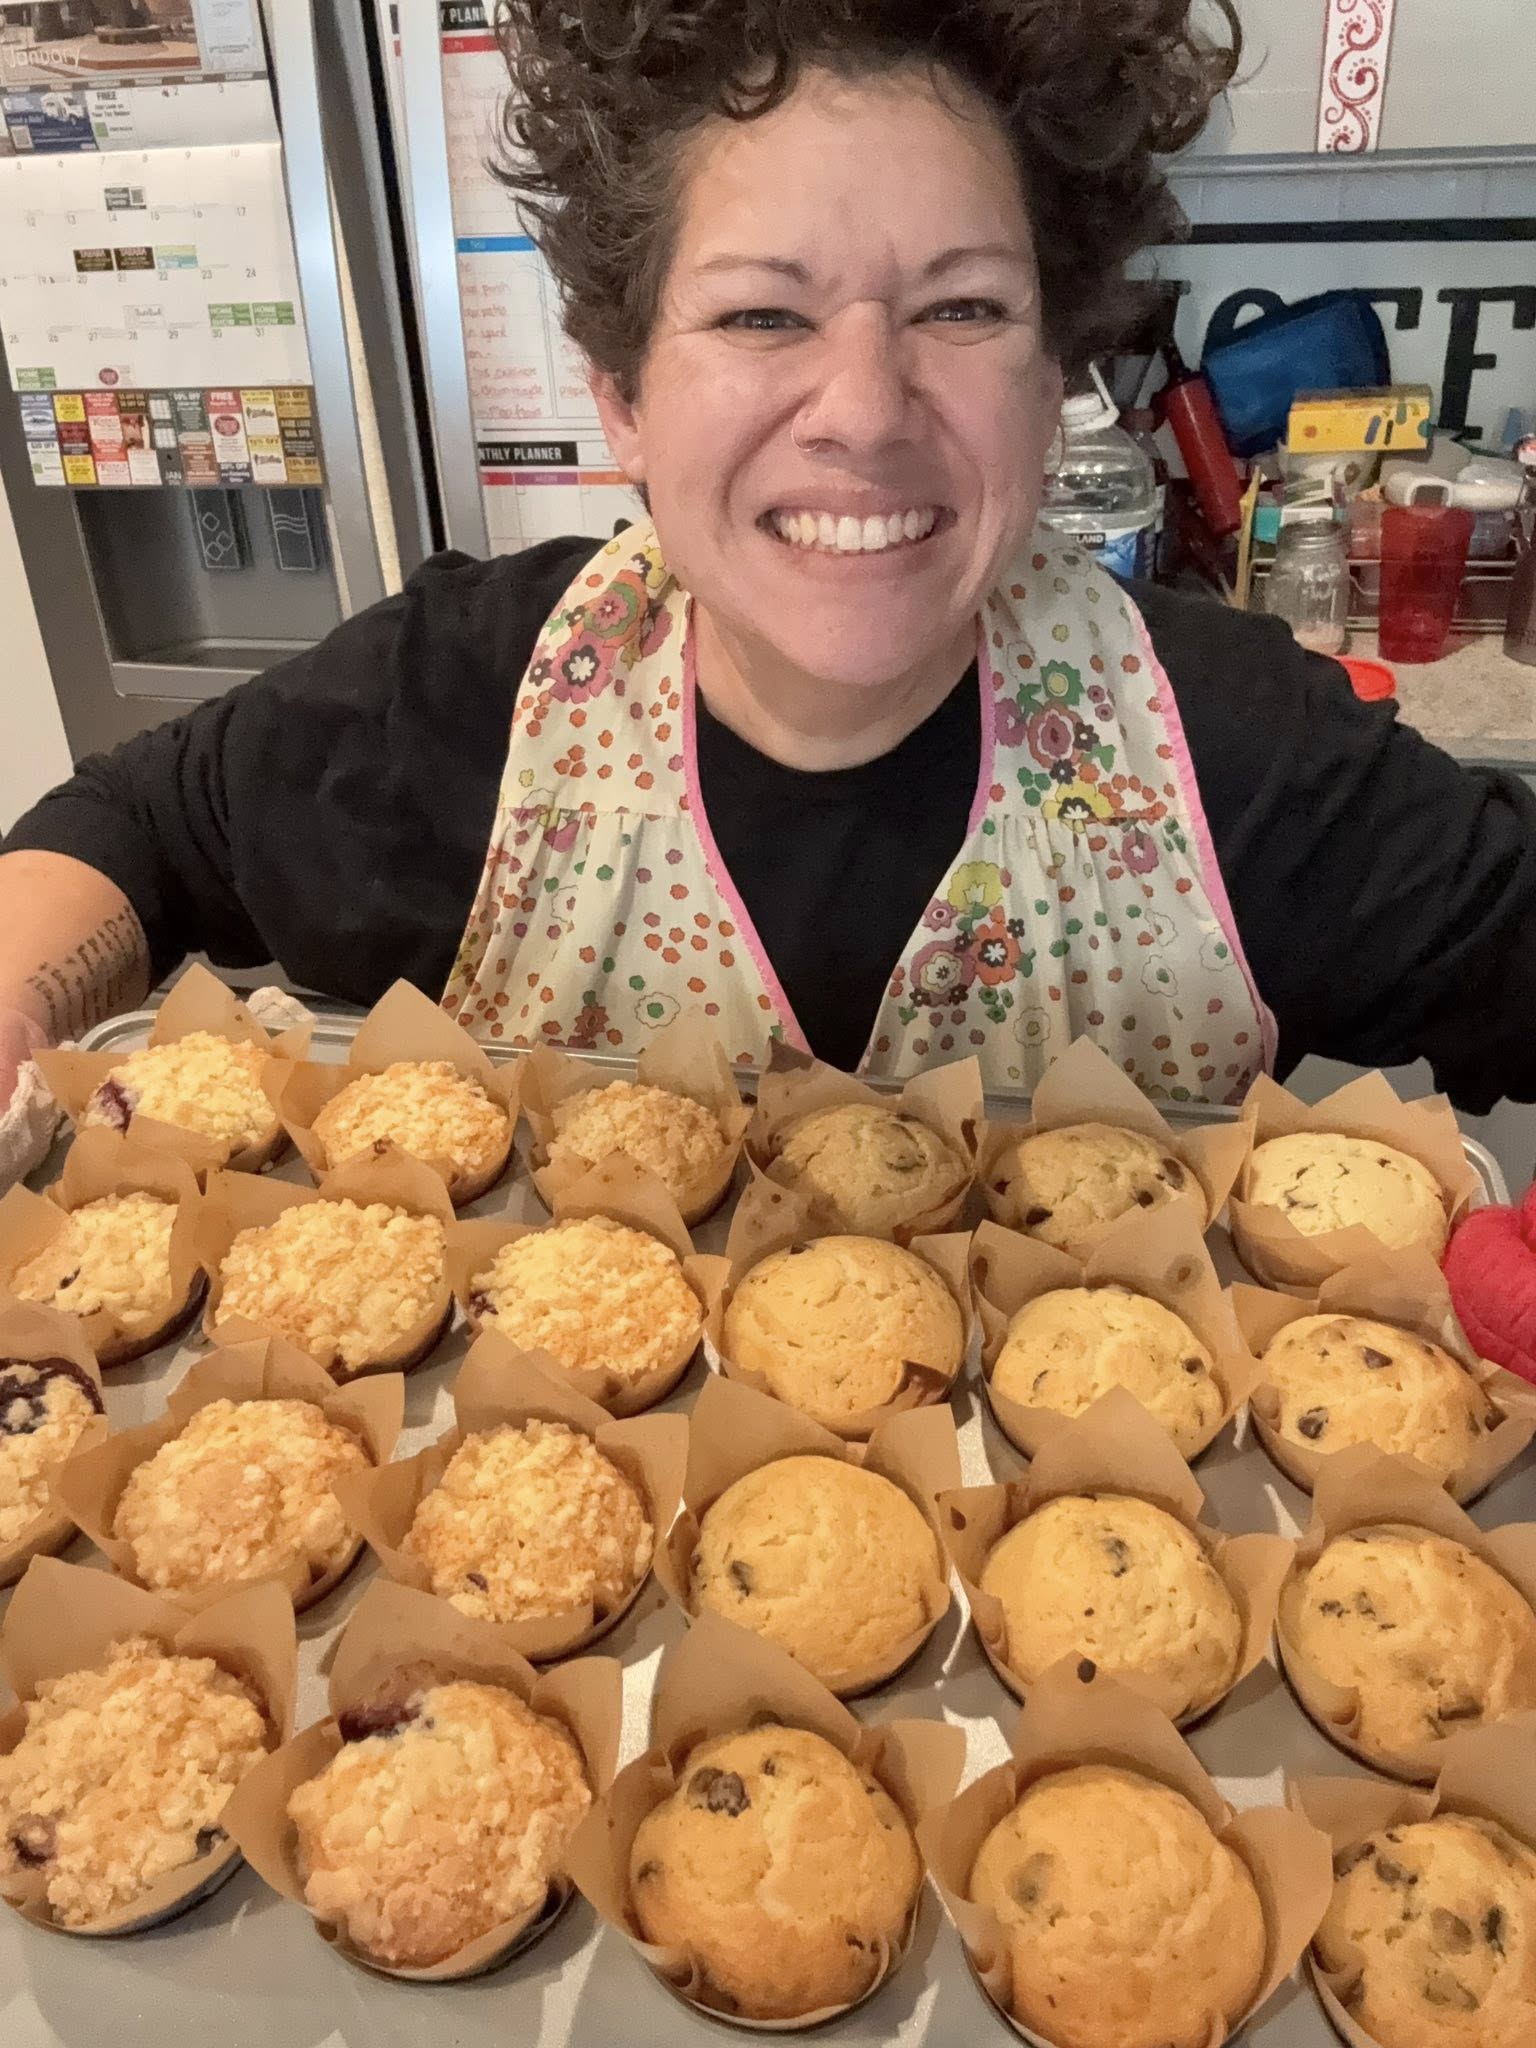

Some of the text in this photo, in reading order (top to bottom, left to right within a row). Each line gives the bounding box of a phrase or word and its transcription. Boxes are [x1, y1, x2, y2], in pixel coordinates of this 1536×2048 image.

[5, 45, 80, 68] January
[96, 91, 117, 100] FREE
[150, 210, 160, 221] 15
[193, 208, 203, 219] 16
[237, 206, 246, 217] 17
[27, 216, 36, 228] 12
[67, 214, 76, 226] 13
[108, 213, 117, 223] 14
[159, 271, 168, 281] 22
[201, 269, 213, 280] 23
[246, 267, 256, 278] 24
[48, 333, 59, 343] 26
[88, 331, 98, 342] 27
[128, 331, 138, 341] 28
[169, 329, 179, 340] 29
[212, 328, 223, 339] 30
[255, 327, 265, 338] 31
[9, 334, 19, 344] 25
[211, 391, 233, 400] FREE
[265, 437, 279, 445] OFF
[513, 447, 562, 460] PLANNER
[165, 471, 182, 480] JAN
